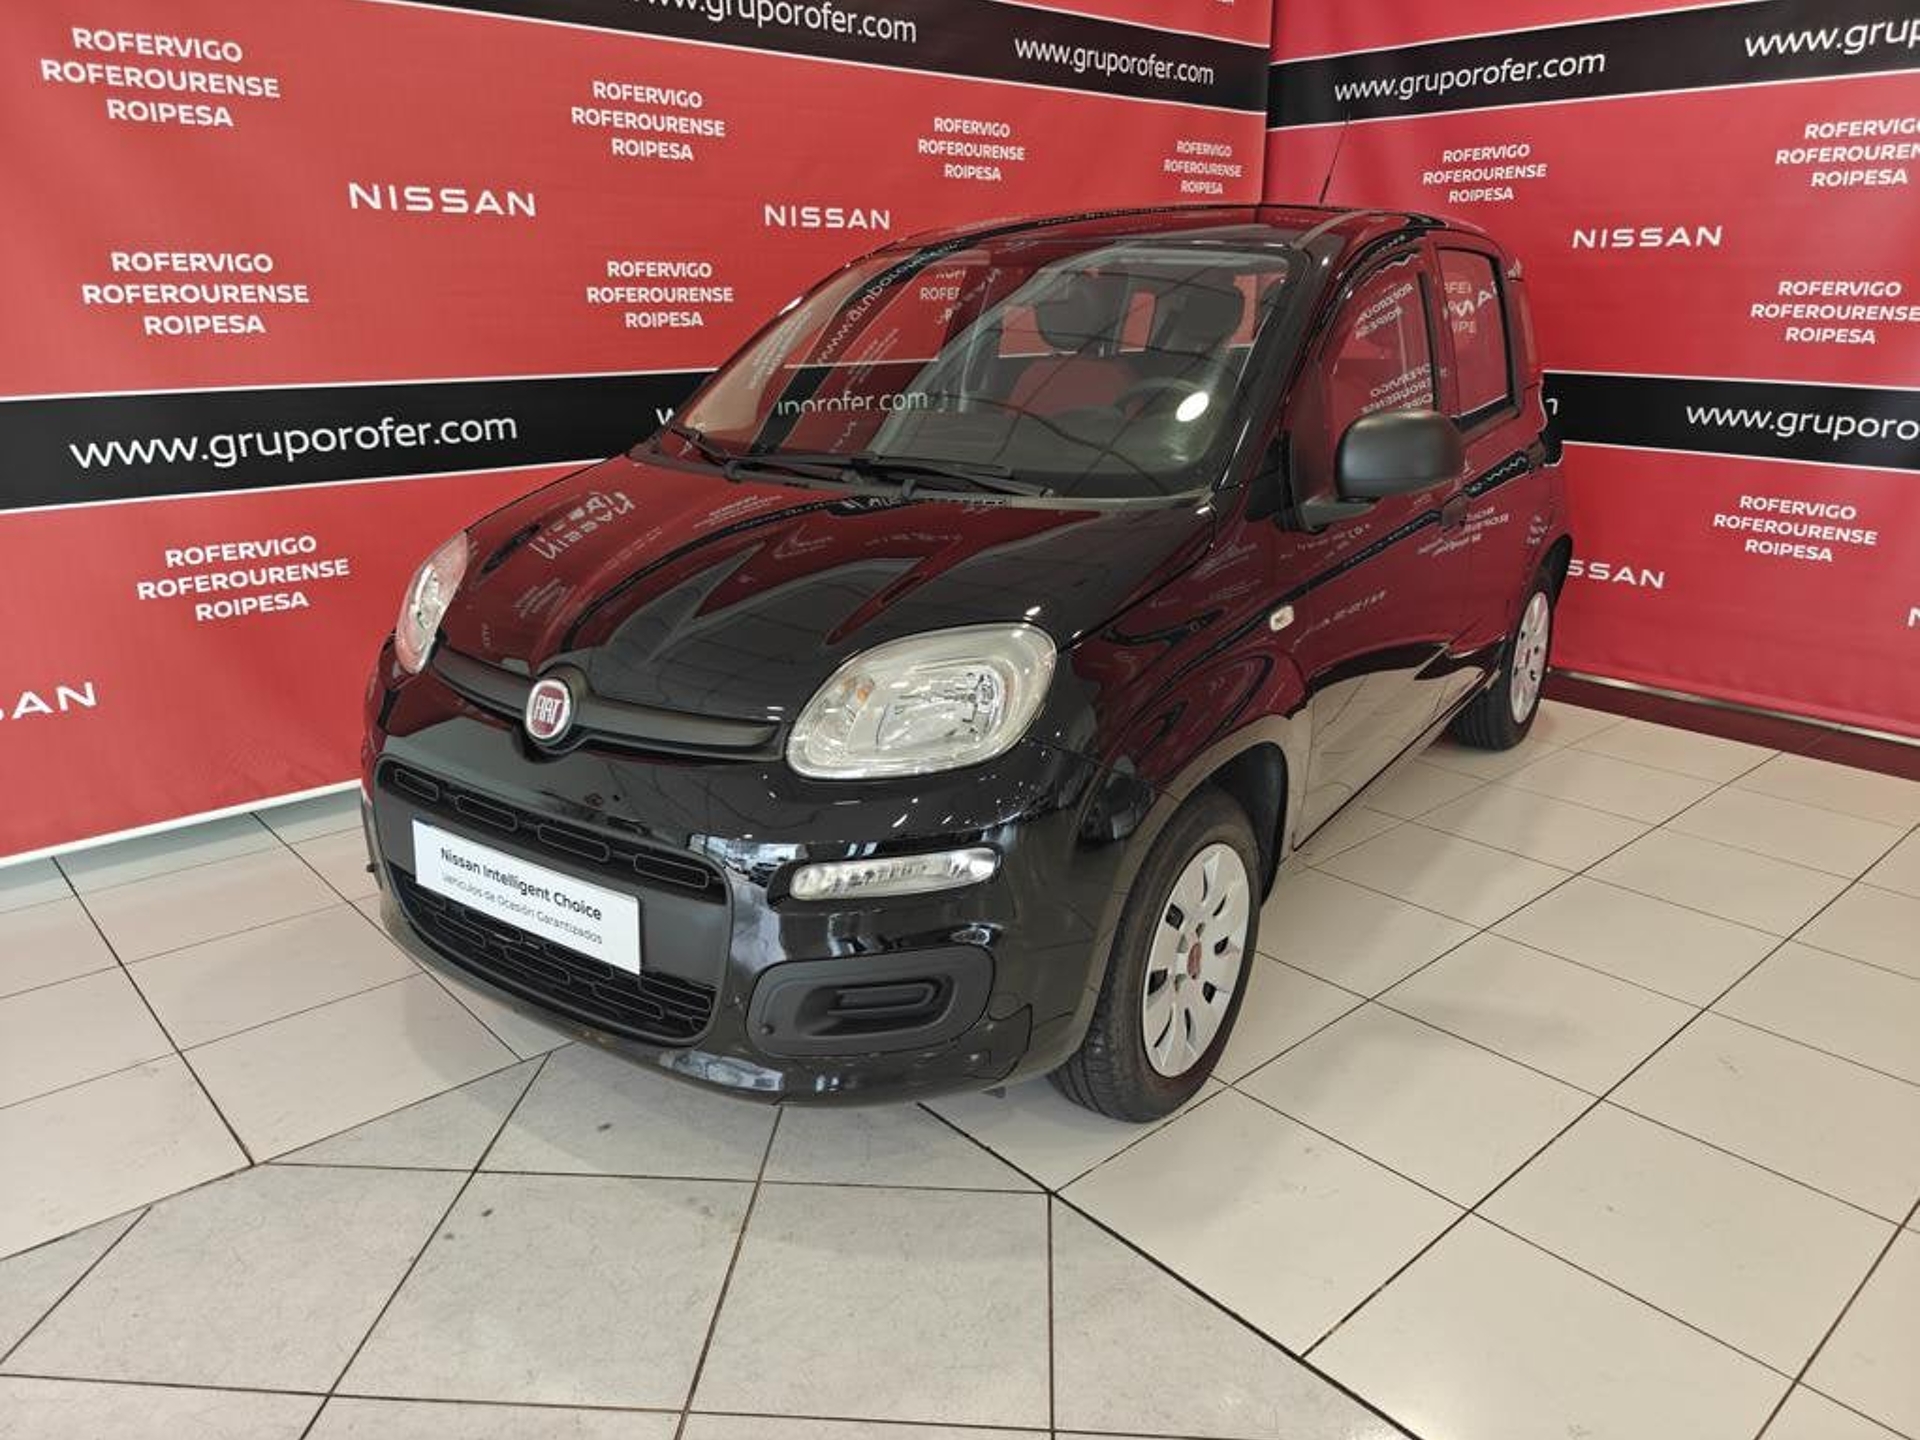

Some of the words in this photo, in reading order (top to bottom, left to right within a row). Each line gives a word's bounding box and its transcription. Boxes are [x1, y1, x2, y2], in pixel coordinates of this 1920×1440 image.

[632, 0, 917, 43] .gruporofer.com
[72, 27, 243, 62] ROFERVIGO
[1014, 36, 1214, 85] www.gruporofer.com
[40, 58, 280, 98] ROFEROURENSE
[1334, 51, 1606, 101] www.gruporofer.com
[592, 80, 703, 109] ROFERVIGO
[106, 99, 234, 127] ROIPESA
[571, 106, 725, 137] ROFEROURENSE
[934, 117, 1011, 138] ROFERVIGO
[1804, 117, 1920, 139] ROFERVIG
[611, 137, 694, 161] ROIPESA
[918, 138, 1025, 161] ROFEROURENSE
[1176, 140, 1232, 157] ROFERVIGO
[1443, 143, 1530, 163] ROFERVIGO
[944, 163, 1002, 181] ROIPESA
[1164, 159, 1242, 178] ROFEROURENSE
[1422, 163, 1548, 185] ROFEROURENSE
[1811, 168, 1908, 187] ROIPESA
[1181, 179, 1223, 194] ROIPESA
[1449, 187, 1514, 203] ROIPESA
[348, 182, 536, 217] NISSAN
[764, 205, 890, 230] NISSAN
[1572, 225, 1722, 248] NISSAN
[111, 252, 273, 273] ROFERVIGO
[607, 260, 712, 278] ROFERVIGO
[82, 284, 309, 304] ROFEROURENSE
[587, 287, 733, 303] ROFEROURENSE
[1778, 281, 1902, 297] ROFERVIGO
[625, 311, 704, 328] ROIPESA
[1750, 303, 1920, 322] ROFEROURENSE
[144, 314, 266, 335] ROIPESA
[1785, 326, 1876, 344] ROIPESA
[1686, 406, 1920, 441] www.gruporo
[69, 416, 518, 469] www.gruporofer.com
[1739, 495, 1857, 521] ROFERVIGO
[1713, 514, 1878, 546] ROFEROURENSE
[165, 535, 318, 567] ROFERVIGO
[1744, 538, 1834, 562] ROIPESA
[136, 558, 350, 600] ROFEROURENSE
[195, 591, 309, 621] ROIPESA
[0, 682, 96, 721] AN
[441, 847, 481, 876] Nissan
[483, 865, 550, 901] Intelligent
[553, 892, 603, 921] Choice
